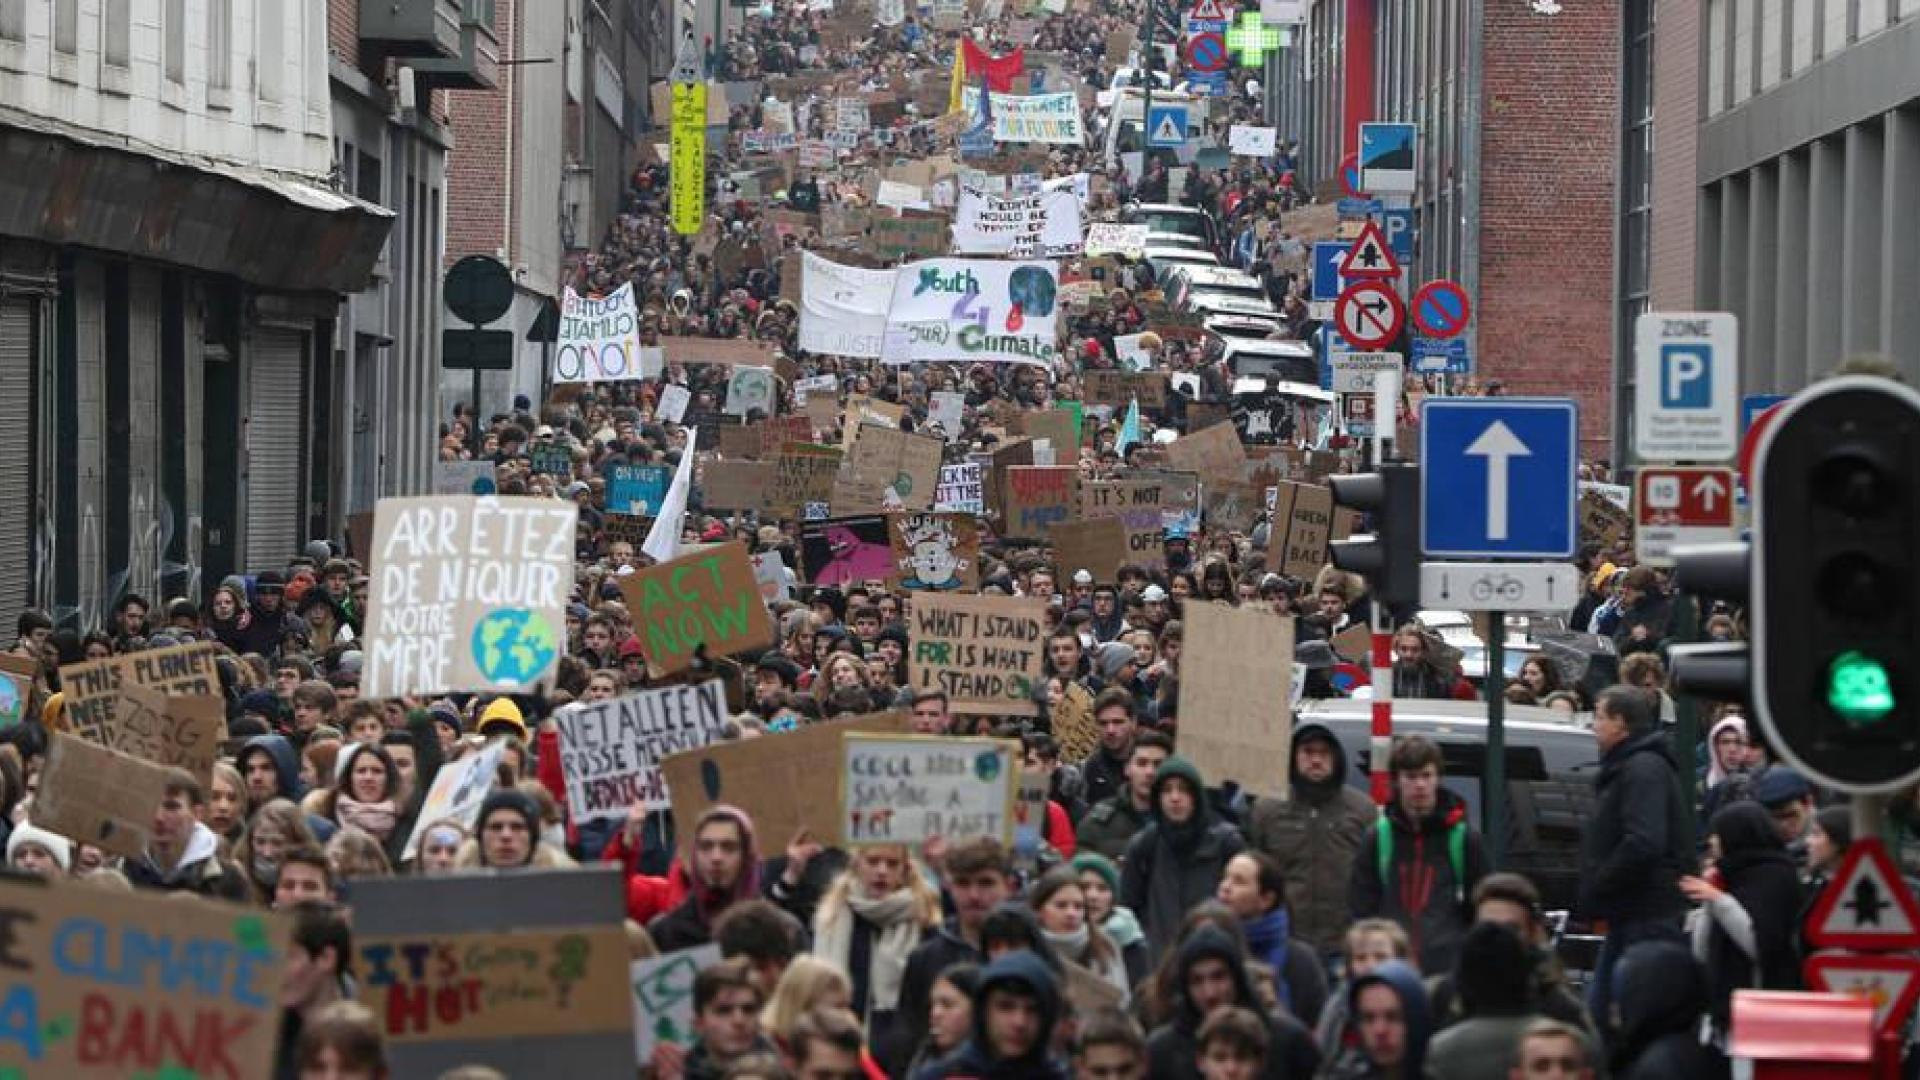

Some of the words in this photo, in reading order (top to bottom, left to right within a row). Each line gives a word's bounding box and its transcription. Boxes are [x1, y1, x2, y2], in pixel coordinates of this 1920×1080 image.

[1660, 320, 1712, 337] ZONE
[1668, 352, 1704, 401] P
[1093, 484, 1126, 506] IT'S
[382, 562, 423, 604] DE
[643, 555, 728, 616] ACT
[379, 602, 457, 634] NOTRE
[647, 587, 752, 663] NOW
[917, 607, 969, 638] WHAT
[973, 613, 980, 638] I
[983, 614, 1040, 642] STAND
[65, 664, 121, 698] THIS
[135, 649, 211, 684] PLANET
[916, 640, 952, 664] FOR
[956, 644, 977, 667] IS
[983, 646, 1034, 671] WHAT
[922, 669, 930, 687] I
[937, 669, 1003, 697] STAND
[618, 683, 720, 740] ALLEEN
[52, 914, 278, 1009] CLIMATE
[385, 976, 484, 1035] HOT
[77, 993, 263, 1080] BANK
